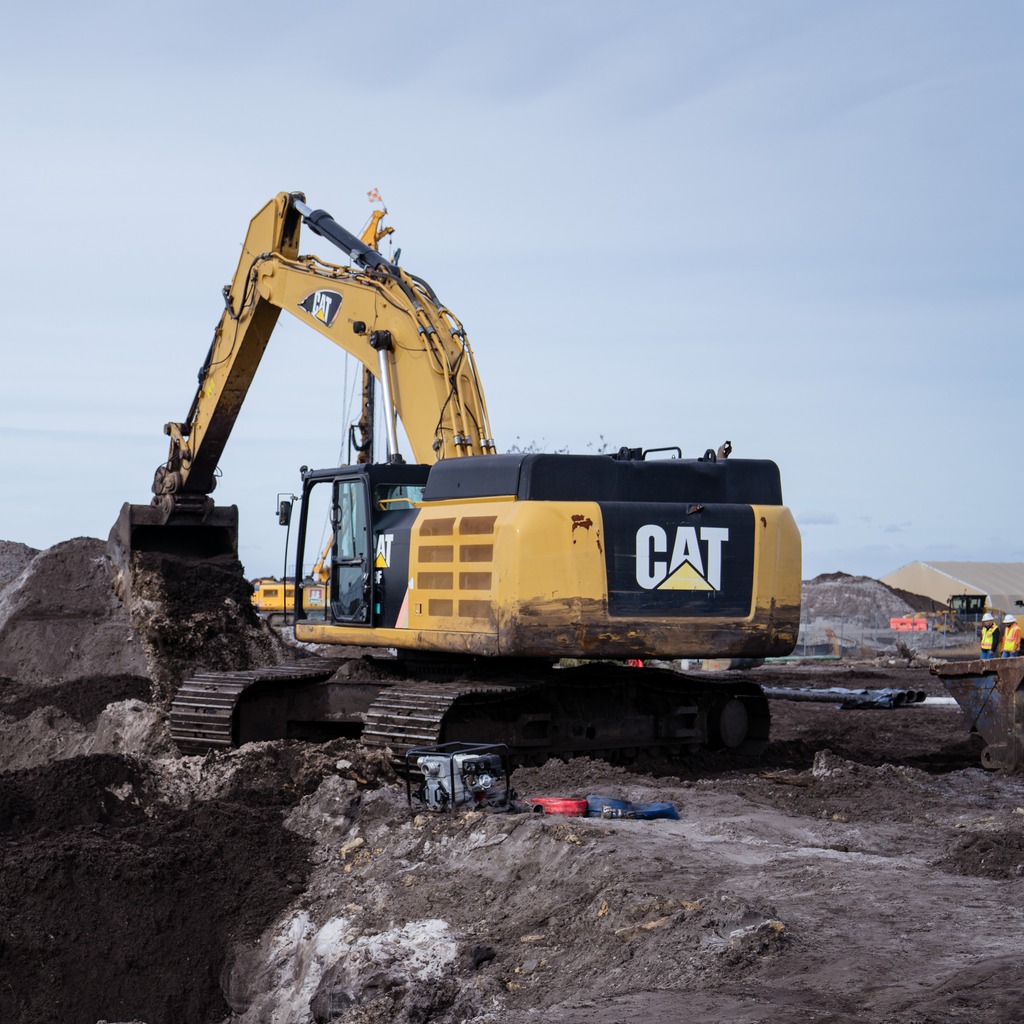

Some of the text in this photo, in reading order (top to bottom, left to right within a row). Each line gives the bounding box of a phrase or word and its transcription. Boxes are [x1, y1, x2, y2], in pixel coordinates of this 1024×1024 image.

[311, 291, 333, 322] CAT
[373, 534, 394, 568] AT
[636, 525, 729, 591] CAT
